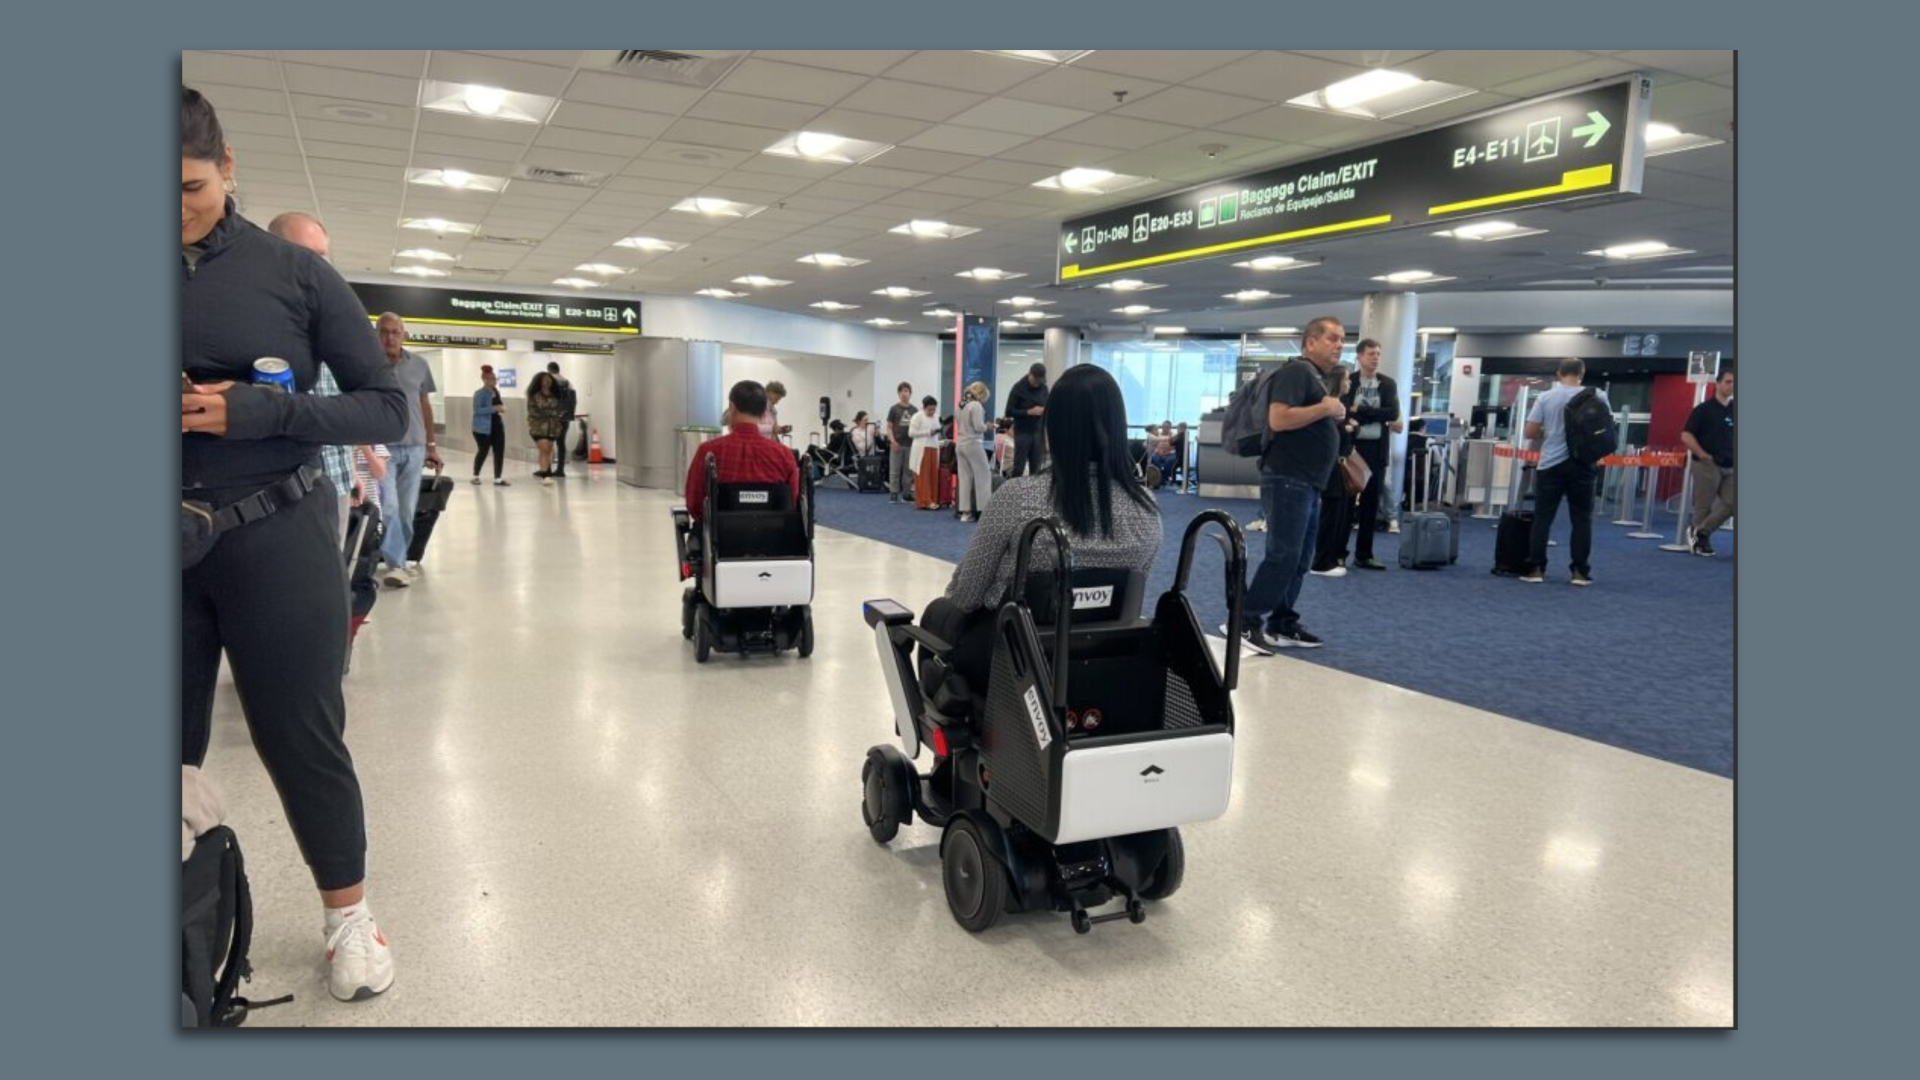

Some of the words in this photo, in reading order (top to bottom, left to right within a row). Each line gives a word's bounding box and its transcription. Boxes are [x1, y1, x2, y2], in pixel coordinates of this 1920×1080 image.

[1452, 136, 1520, 169] E4-E11
[1240, 181, 1295, 205] Baggage
[1297, 158, 1378, 193] Claim/EXIT
[1240, 204, 1274, 220] Reclamo
[1274, 201, 1286, 214] de
[1286, 188, 1355, 213] Equipaje/Salida
[1150, 209, 1193, 232] E20-E33
[1096, 224, 1129, 244] D1-D60
[451, 298, 492, 309] Baggage
[493, 301, 544, 312] Claim/EXIT
[1622, 334, 1660, 356] E2
[739, 493, 766, 501] envoy
[1072, 589, 1108, 604] nvoy
[1027, 688, 1051, 742] envoy
